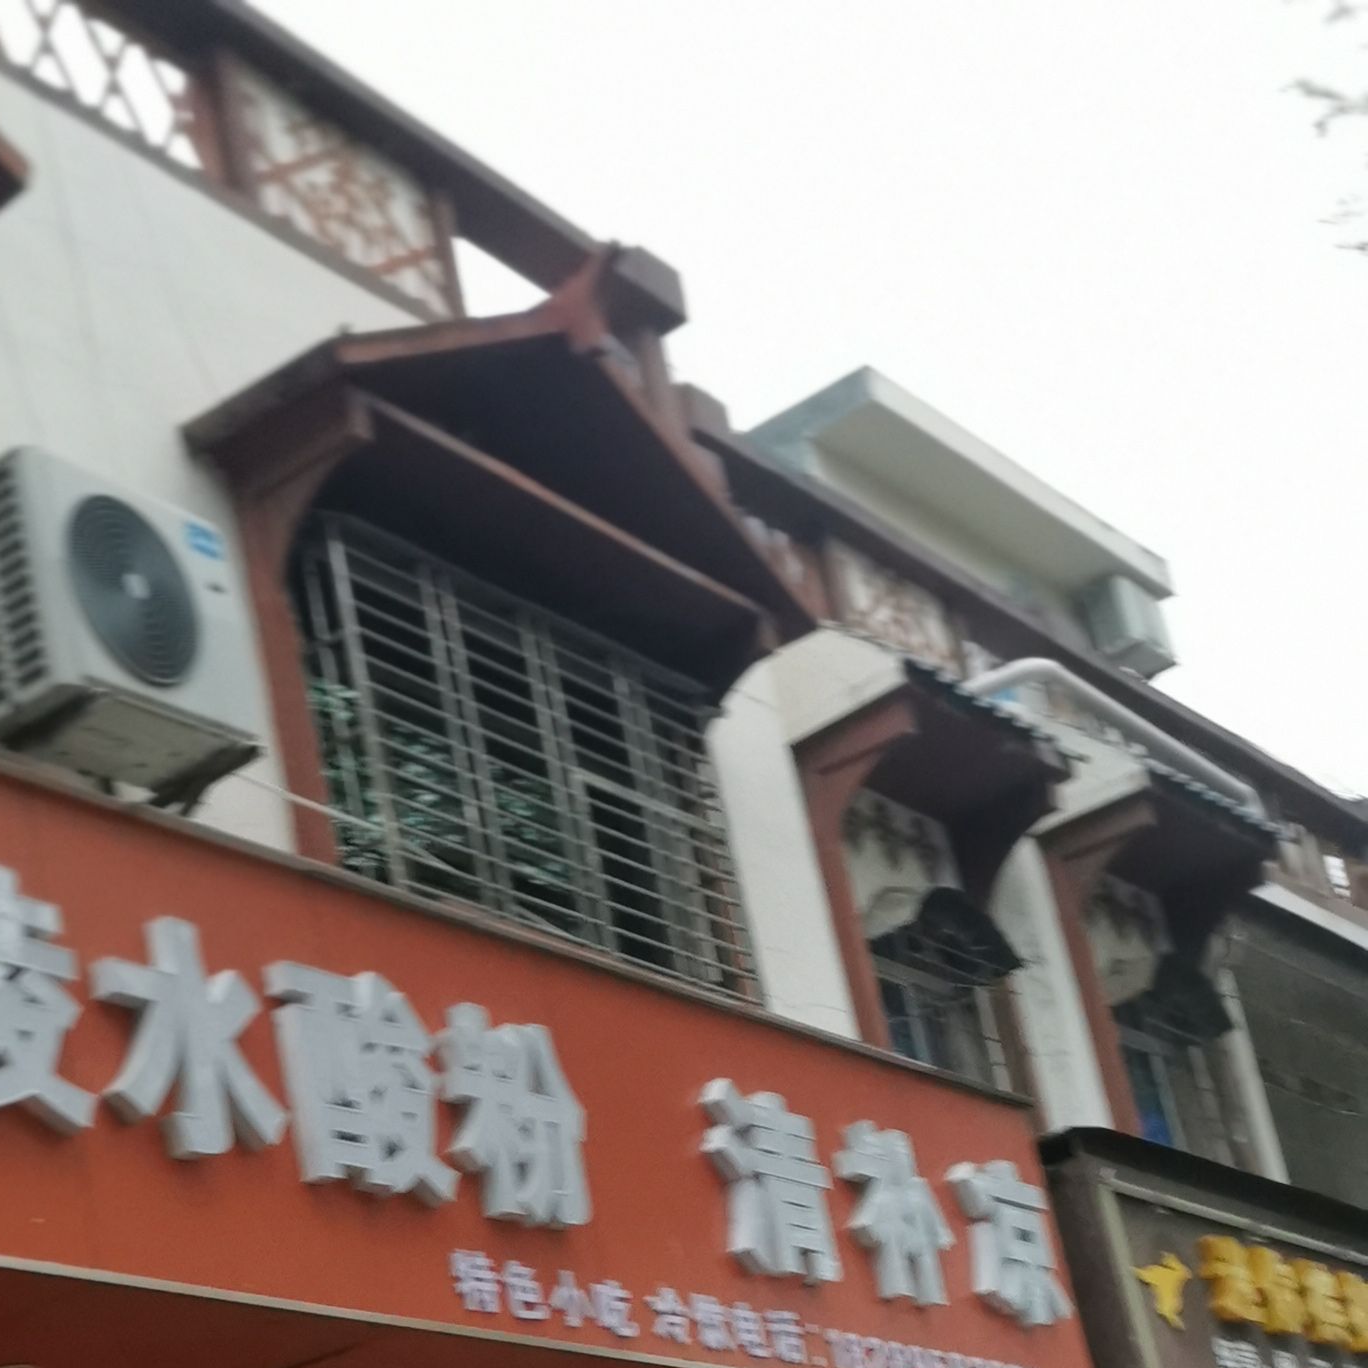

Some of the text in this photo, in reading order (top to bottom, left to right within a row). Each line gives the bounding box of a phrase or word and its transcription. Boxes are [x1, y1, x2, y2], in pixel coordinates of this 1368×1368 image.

[699, 1077, 1074, 1328] 清补凉
[448, 1248, 641, 1338] 特色小吃
